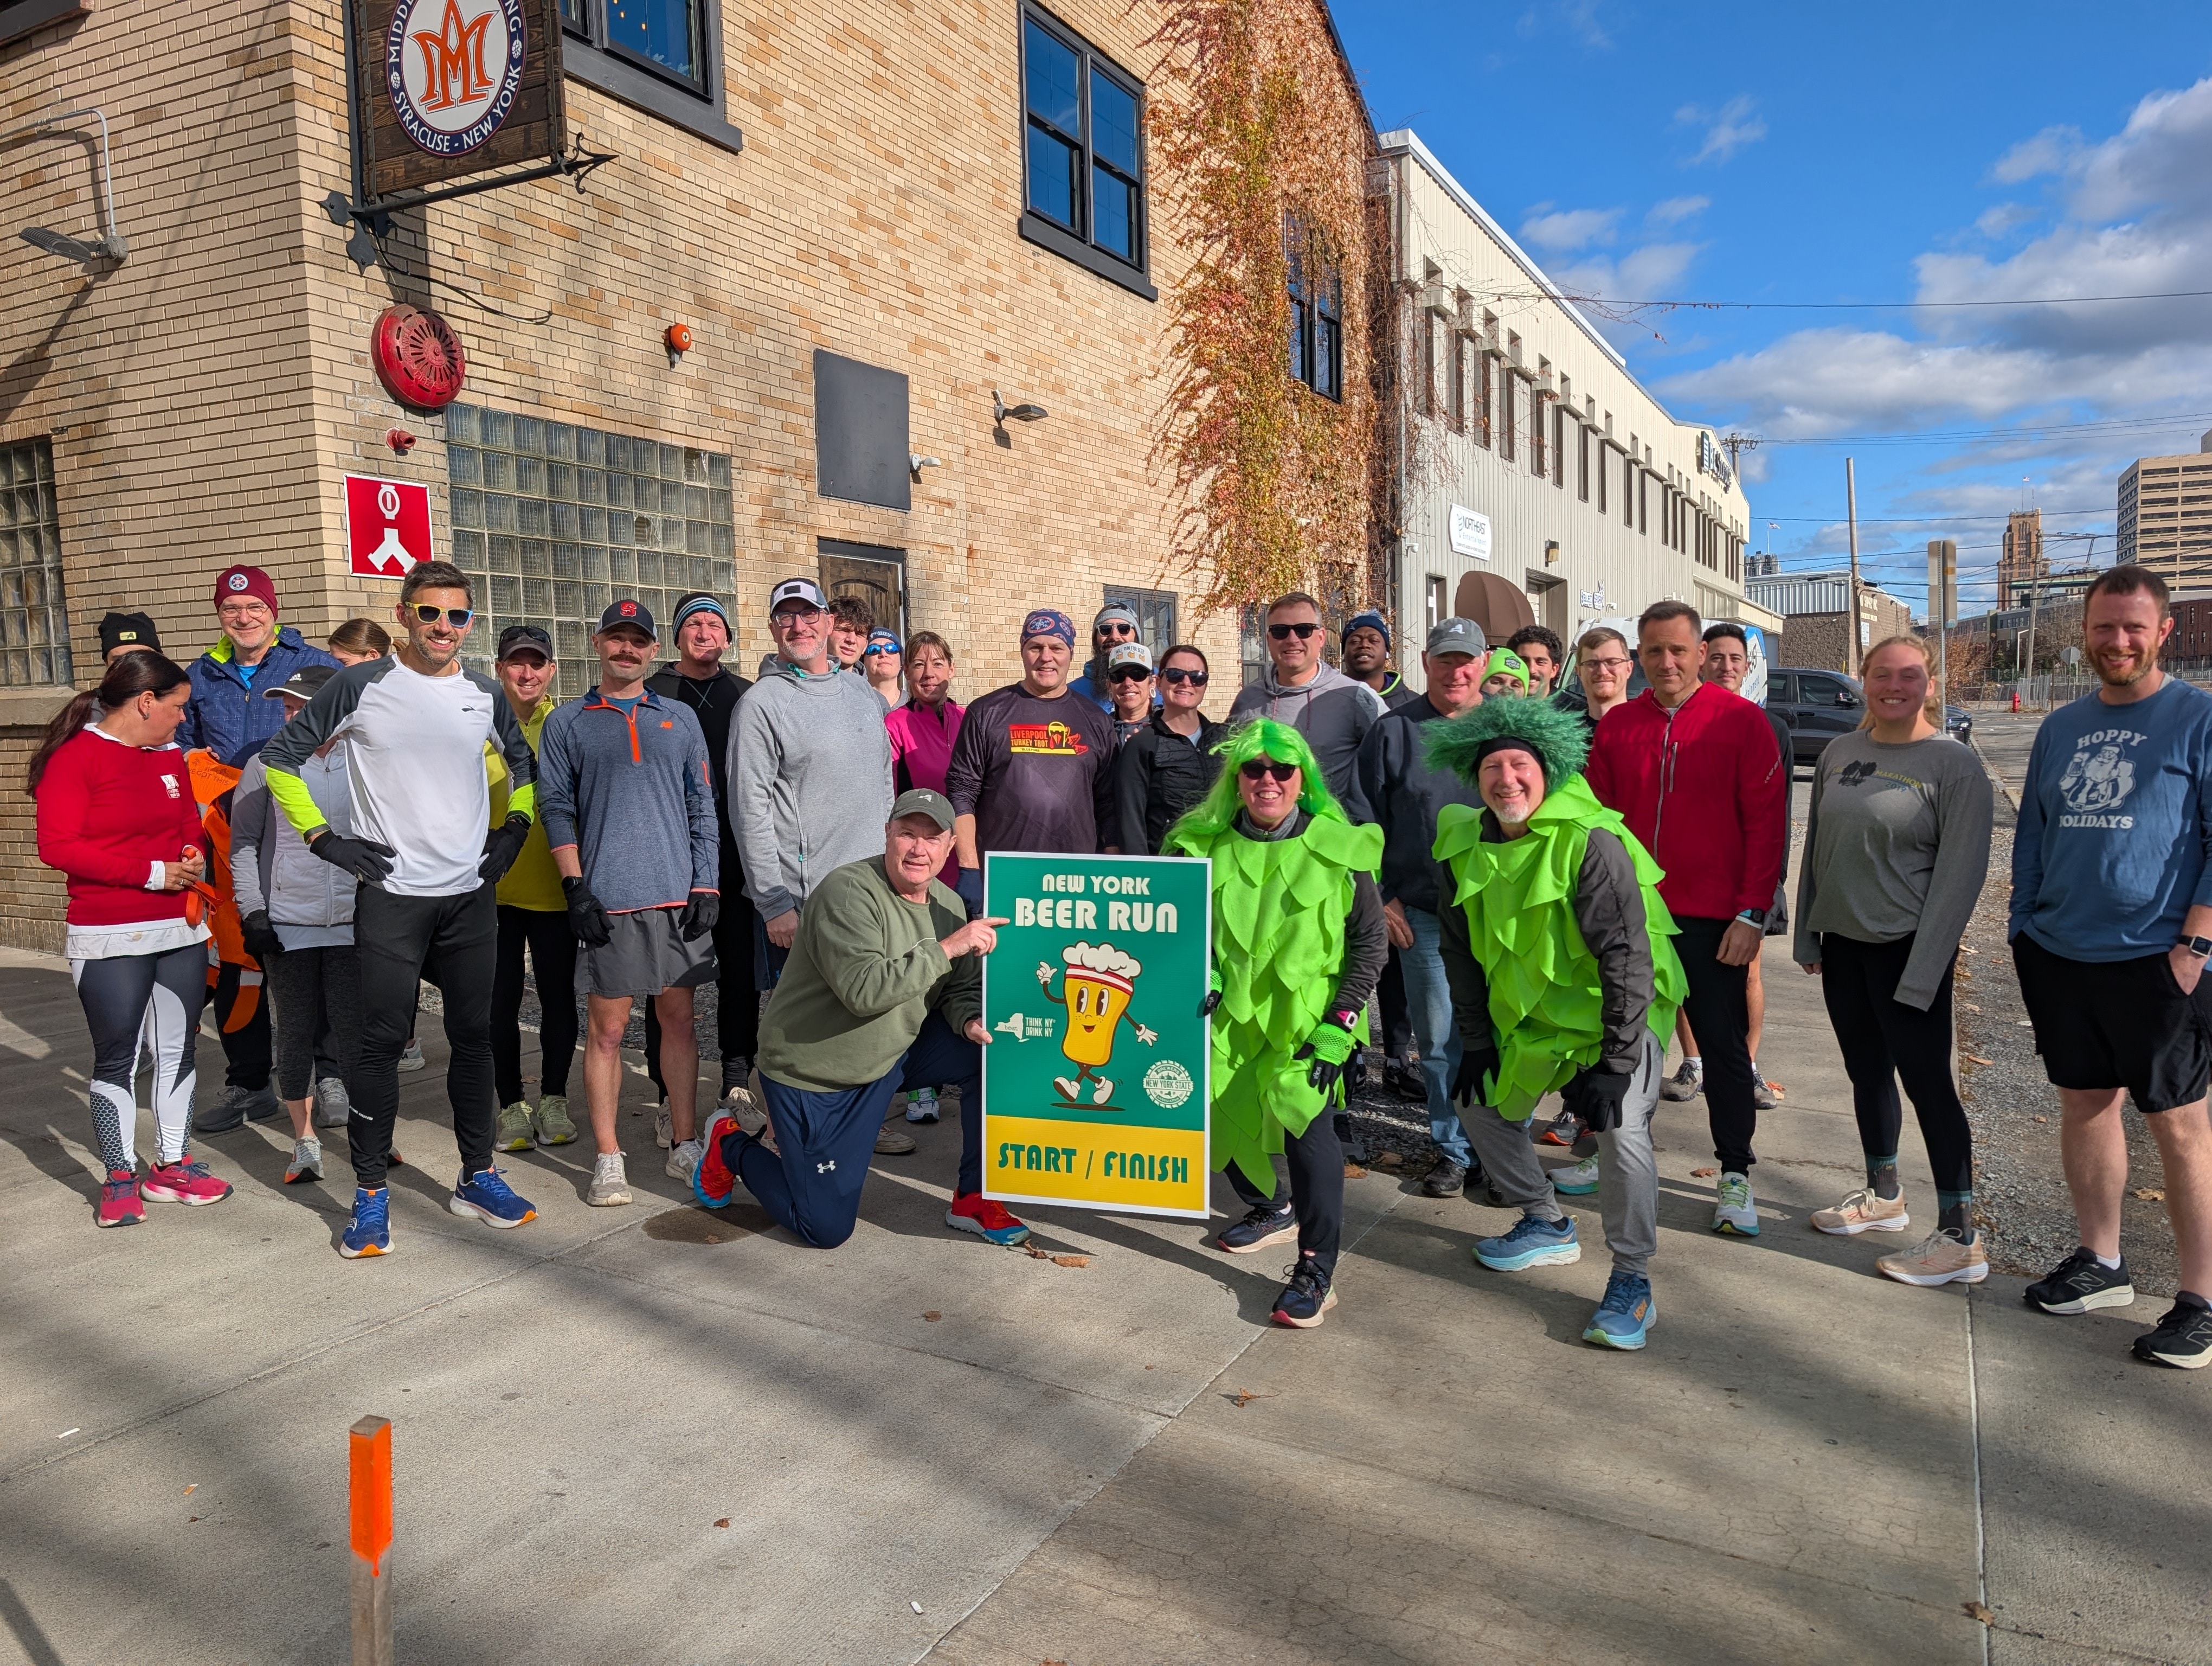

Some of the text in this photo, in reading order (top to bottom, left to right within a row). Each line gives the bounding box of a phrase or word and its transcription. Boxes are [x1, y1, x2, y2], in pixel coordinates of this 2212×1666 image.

[395, 92, 451, 152] SYRACUSE
[462, 116, 493, 149] NEW
[495, 65, 521, 118] YORK
[620, 603, 636, 616] S
[1010, 730, 1048, 739] LIVERPOOL
[2077, 729, 2147, 749] HOPPY
[197, 770, 213, 779] GOT
[213, 775, 229, 785] THIS
[1875, 770, 1922, 789] MARATHON
[1885, 782, 1907, 792] 2019
[1042, 874, 1150, 895] NEW YORK
[1015, 898, 1178, 933] BEER RUN
[1025, 1017, 1042, 1027] THINK
[1026, 1027, 1052, 1037] DRINK NY
[1175, 1081, 1191, 1090] STATE
[998, 1142, 1077, 1173] START
[1103, 1150, 1188, 1184] FINISH
